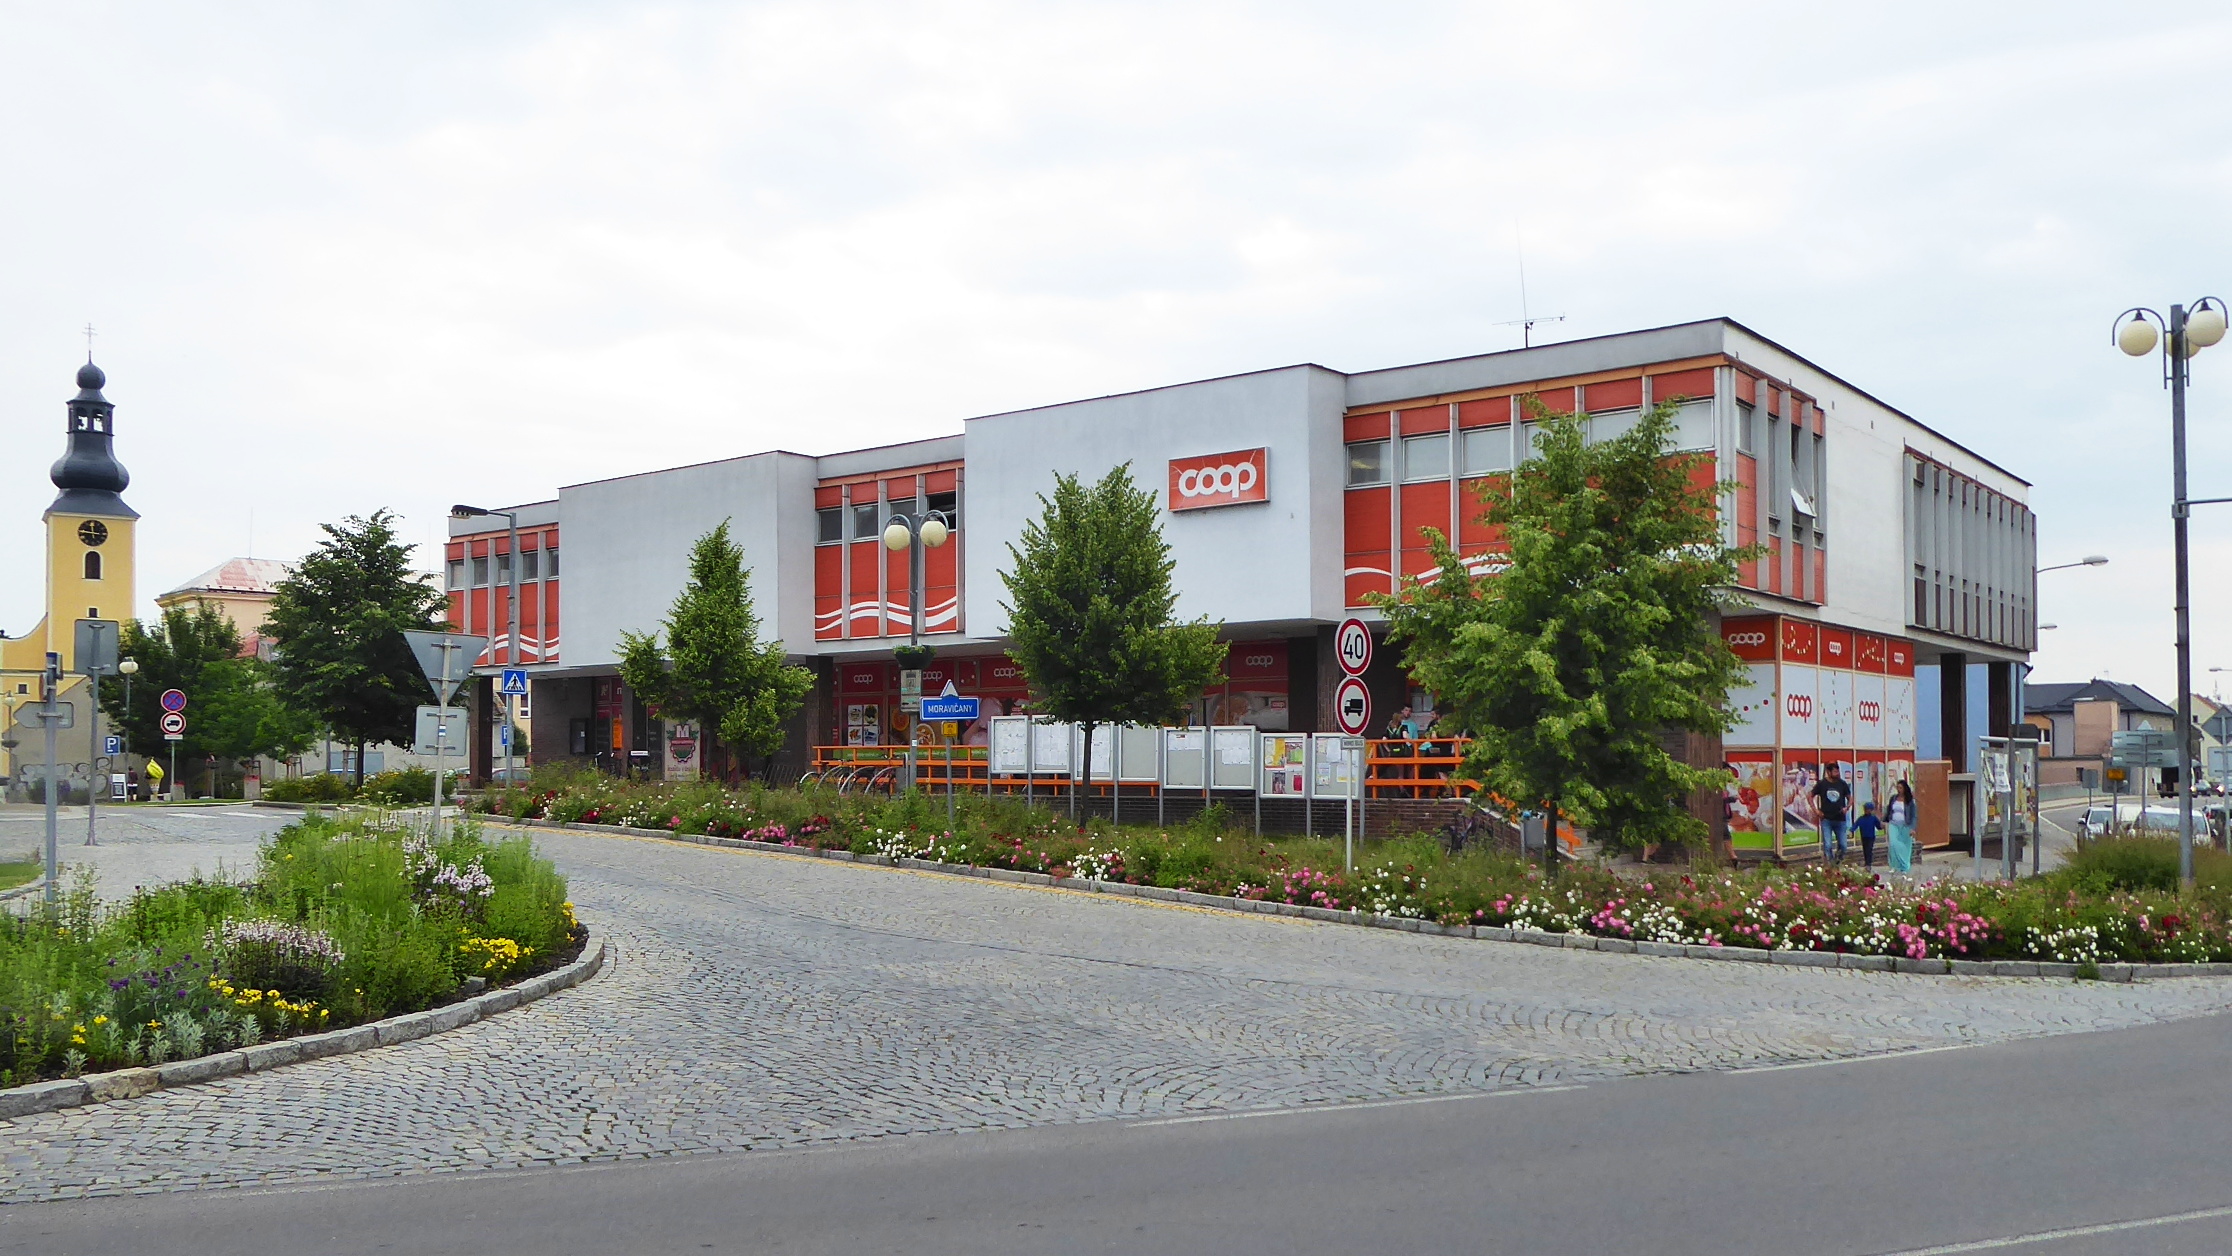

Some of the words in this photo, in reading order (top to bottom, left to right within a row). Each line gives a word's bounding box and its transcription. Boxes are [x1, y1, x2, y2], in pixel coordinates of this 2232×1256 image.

[1178, 462, 1257, 499] coop
[1728, 632, 1765, 646] coop
[1343, 633, 1364, 659] 40
[1246, 655, 1273, 667] coop
[922, 671, 942, 682] coop
[994, 667, 1016, 678] coop
[853, 674, 873, 684] coop
[928, 703, 973, 713] MORAVIČANY
[1787, 694, 1812, 723] coop
[1859, 700, 1880, 727] coop
[107, 737, 117, 748] P
